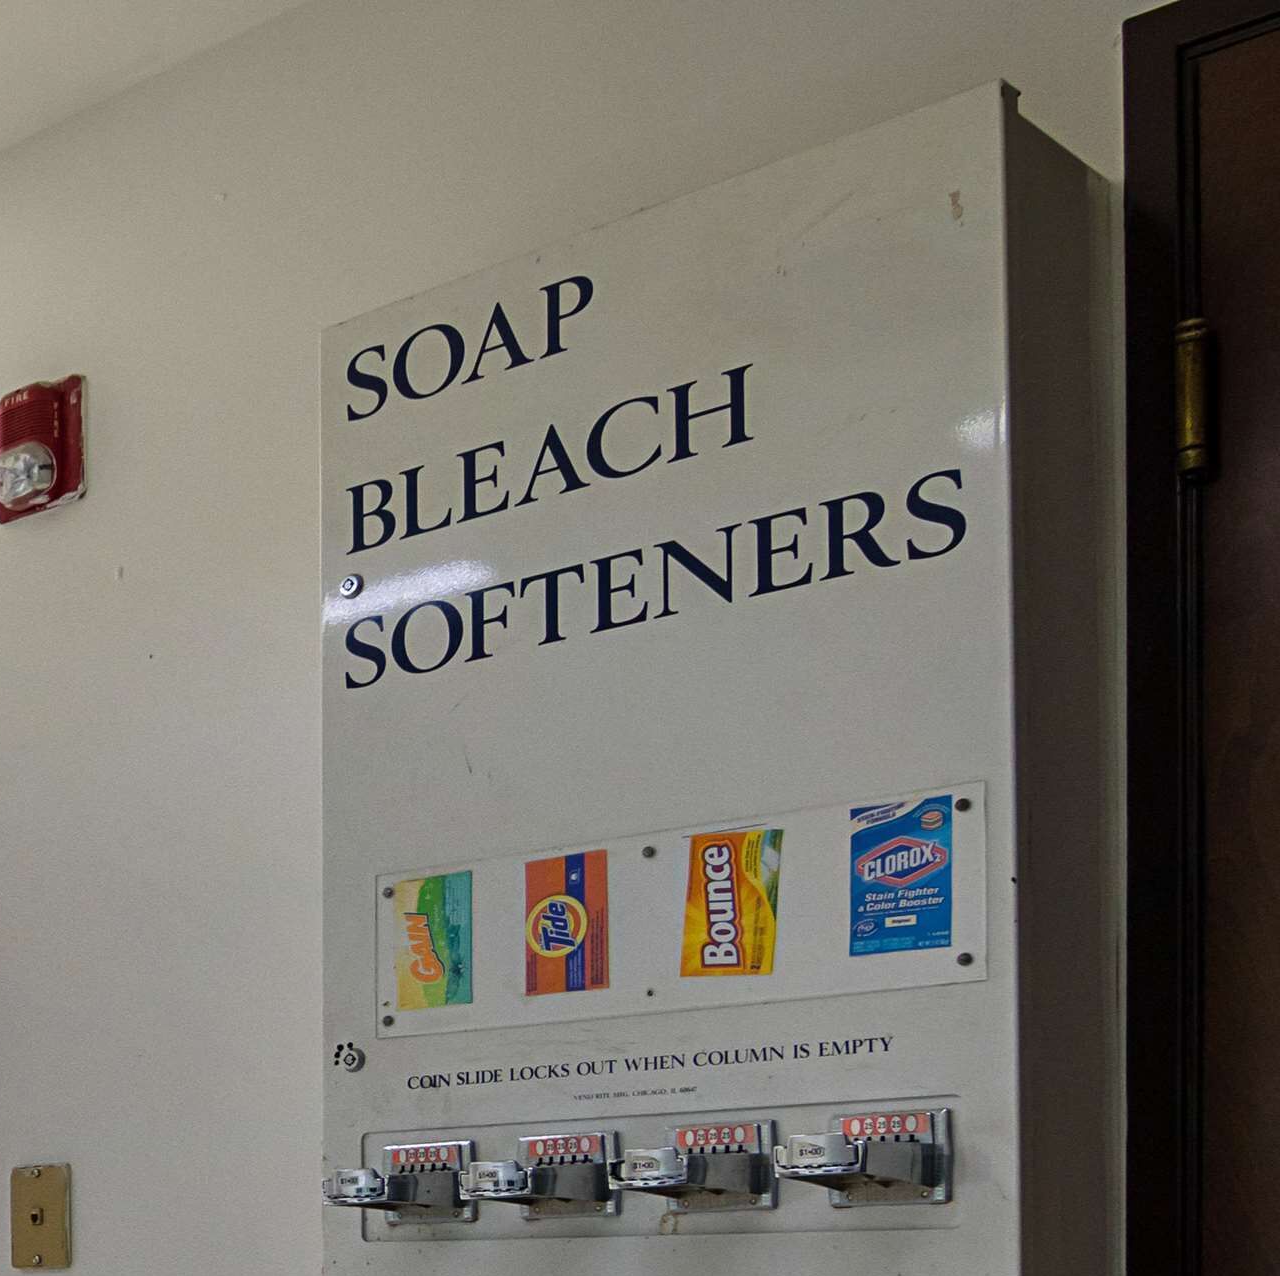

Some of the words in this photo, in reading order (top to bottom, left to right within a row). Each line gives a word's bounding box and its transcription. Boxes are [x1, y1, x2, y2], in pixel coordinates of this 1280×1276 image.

[346, 275, 594, 422] SOAP
[4, 391, 29, 407] FIRE
[346, 363, 754, 555] BLEACH
[344, 468, 968, 690] SOFTENERS
[862, 841, 937, 881] CLOROX
[703, 846, 739, 966] Bounce
[864, 891, 895, 902] Stain
[897, 886, 939, 899] Fighter
[866, 902, 896, 912] Color
[898, 896, 945, 908] Booster
[542, 900, 577, 952] Tide
[407, 1073, 451, 1090] COIN
[456, 1068, 503, 1086] SLIDE
[509, 1063, 570, 1082] LOCKS
[576, 1059, 617, 1076] OUT
[624, 1053, 686, 1072] WHEN
[692, 1045, 785, 1068] COLUMN
[793, 1042, 810, 1060] IS
[818, 1035, 893, 1058] EMPTY
